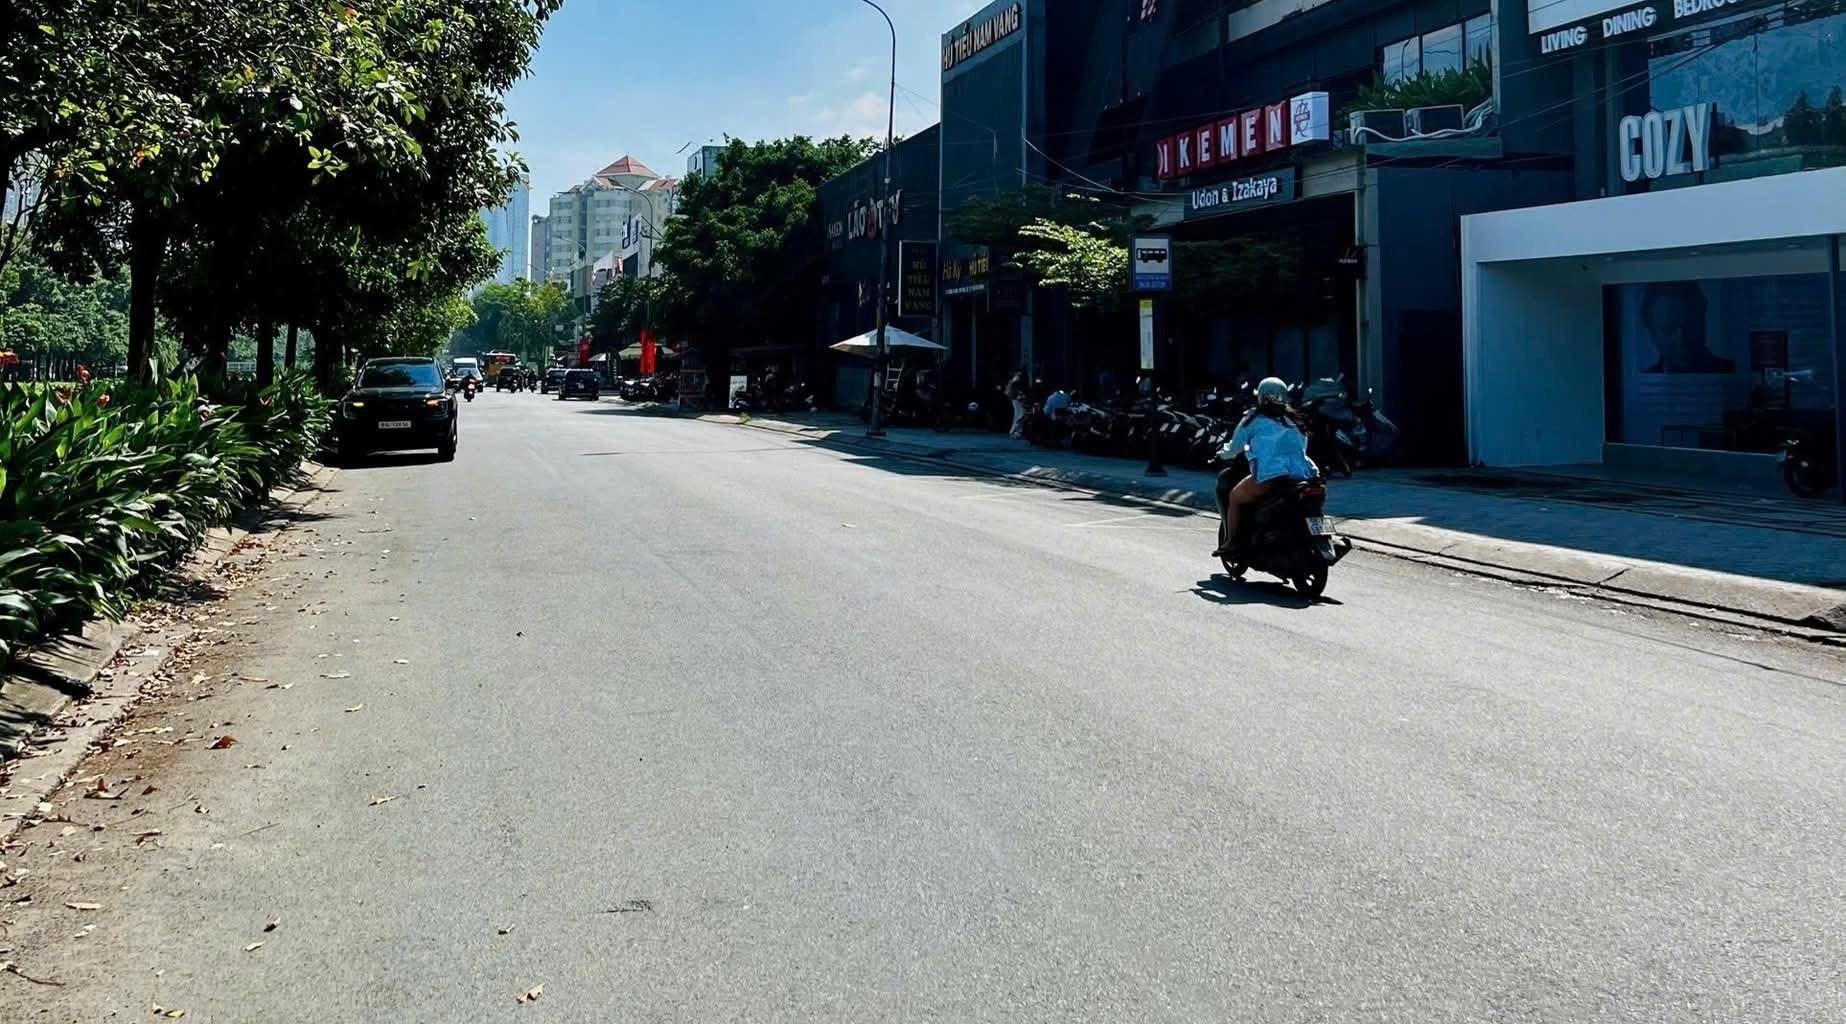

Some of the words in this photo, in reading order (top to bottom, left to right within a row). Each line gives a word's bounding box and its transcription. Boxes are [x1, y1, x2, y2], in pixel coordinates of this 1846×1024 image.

[973, 19, 993, 53] NAM
[993, 2, 1020, 41] VANG
[1541, 25, 1588, 54] LIVING
[1602, 6, 1657, 38] DINING
[1618, 103, 1710, 182] COZY
[1191, 187, 1219, 209] Udon
[1221, 190, 1230, 204] &
[1231, 176, 1278, 201] Izakaya
